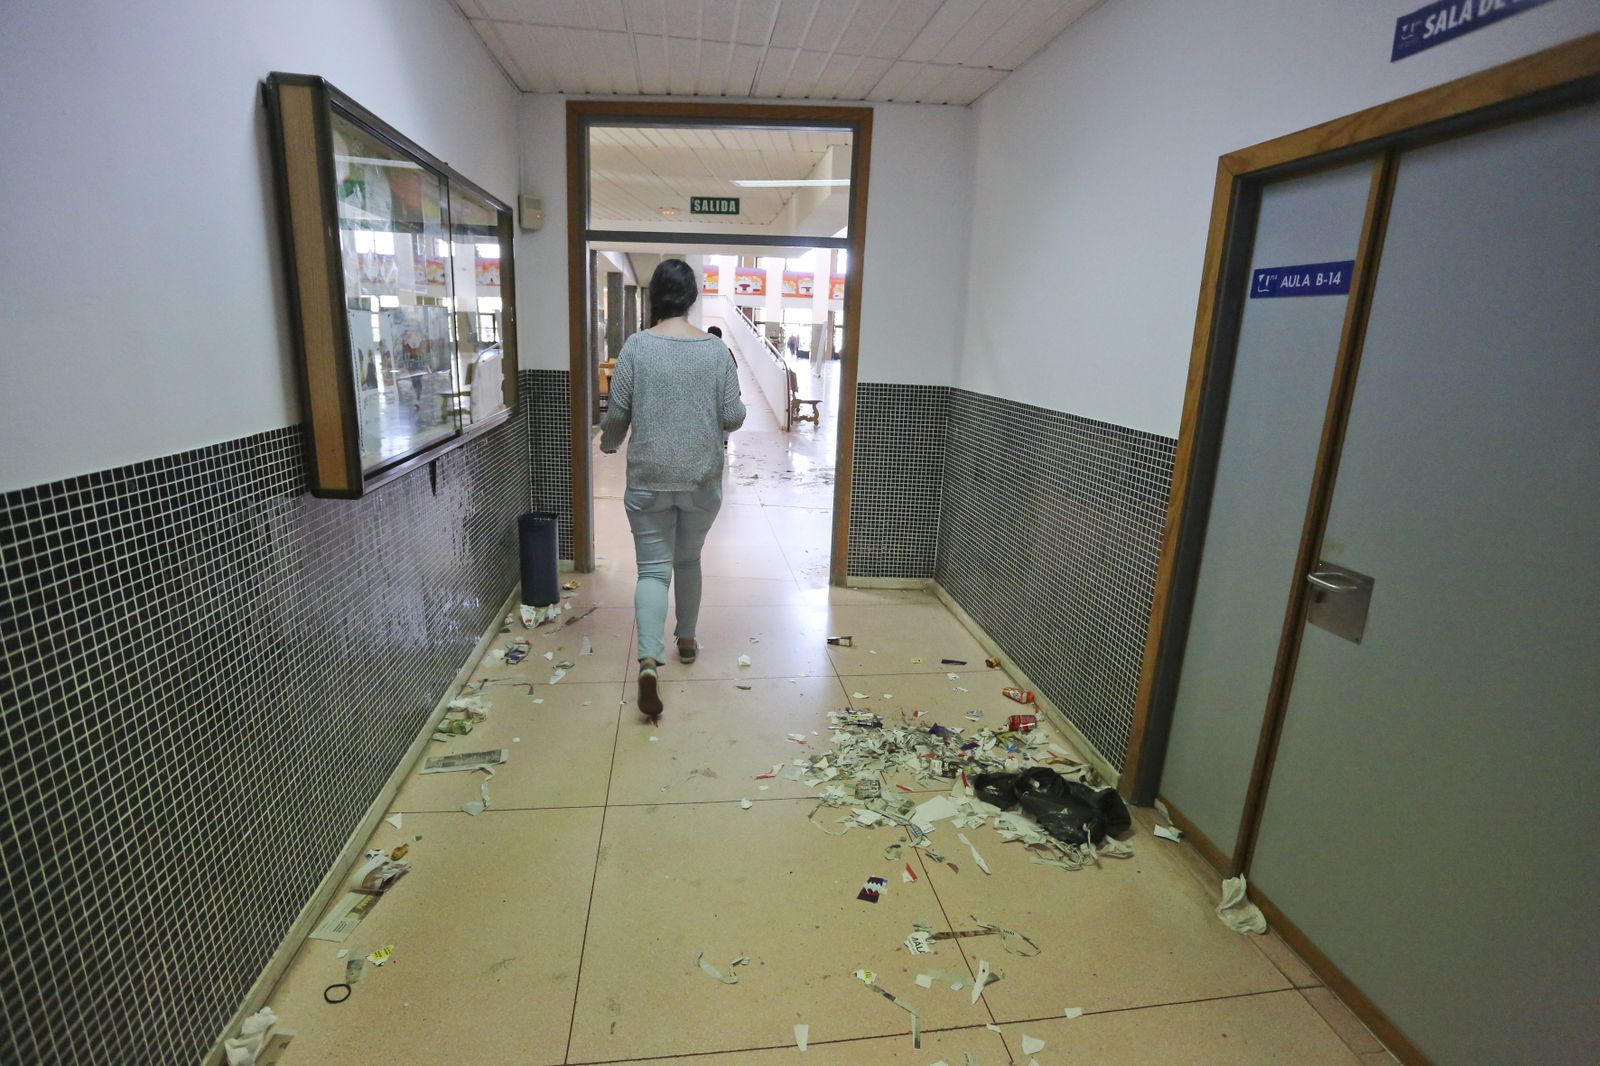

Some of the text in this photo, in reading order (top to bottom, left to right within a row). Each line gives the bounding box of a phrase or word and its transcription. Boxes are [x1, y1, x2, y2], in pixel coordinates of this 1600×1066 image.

[1422, 0, 1473, 39] SALA
[693, 199, 736, 212] SALIDA
[1280, 271, 1342, 288] AULA B-14
